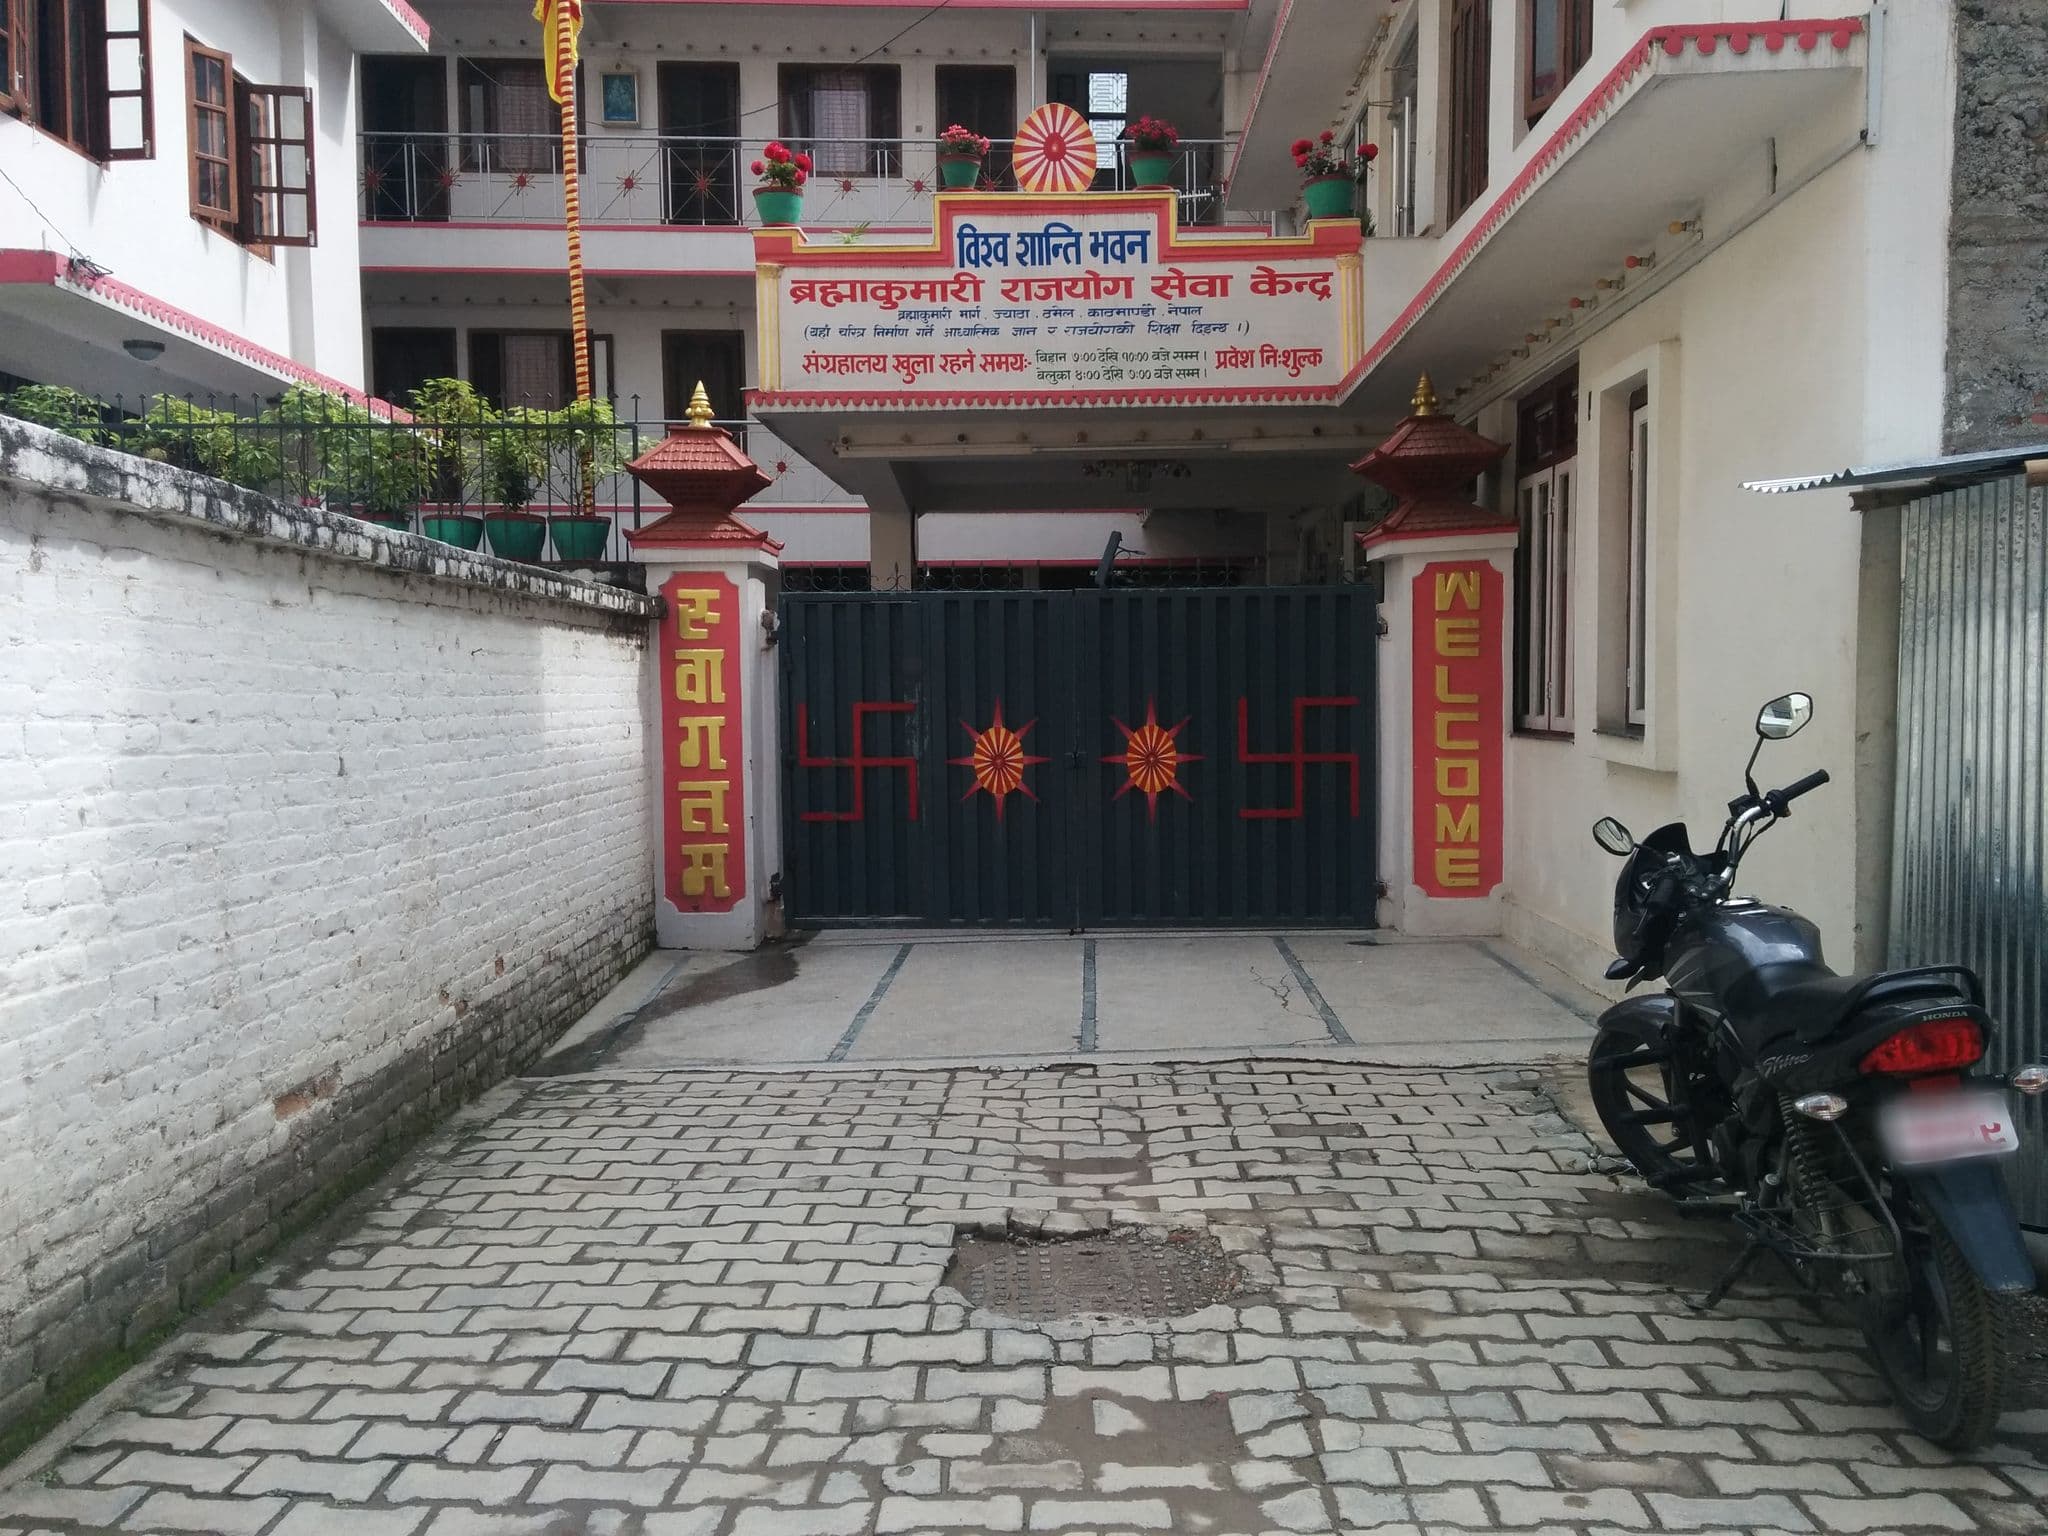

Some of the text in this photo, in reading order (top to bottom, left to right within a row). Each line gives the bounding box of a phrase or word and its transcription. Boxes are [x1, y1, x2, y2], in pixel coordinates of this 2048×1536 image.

[957, 222, 1151, 268] विश्व शान्ति भवन
[789, 266, 1334, 310] ब्रह्माकुमारी राजयोग सेवा केन्द्र
[1168, 303, 1203, 316] नेपाल
[873, 323, 909, 338] निर्माण
[1047, 326, 1058, 336] र
[1147, 320, 1182, 336] शिक्षा
[1097, 347, 1119, 363] देखि
[1172, 350, 1200, 362] सम्म
[1215, 345, 1255, 370] प्रवेश
[802, 349, 888, 376] संग्रहालय
[892, 353, 935, 385] खुला
[939, 347, 976, 375] रहने
[1102, 365, 1124, 381] देखि
[1176, 367, 1200, 380] सम्म
[1435, 570, 1482, 888] WELCOME
[1922, 1010, 1969, 1022] HONDA
